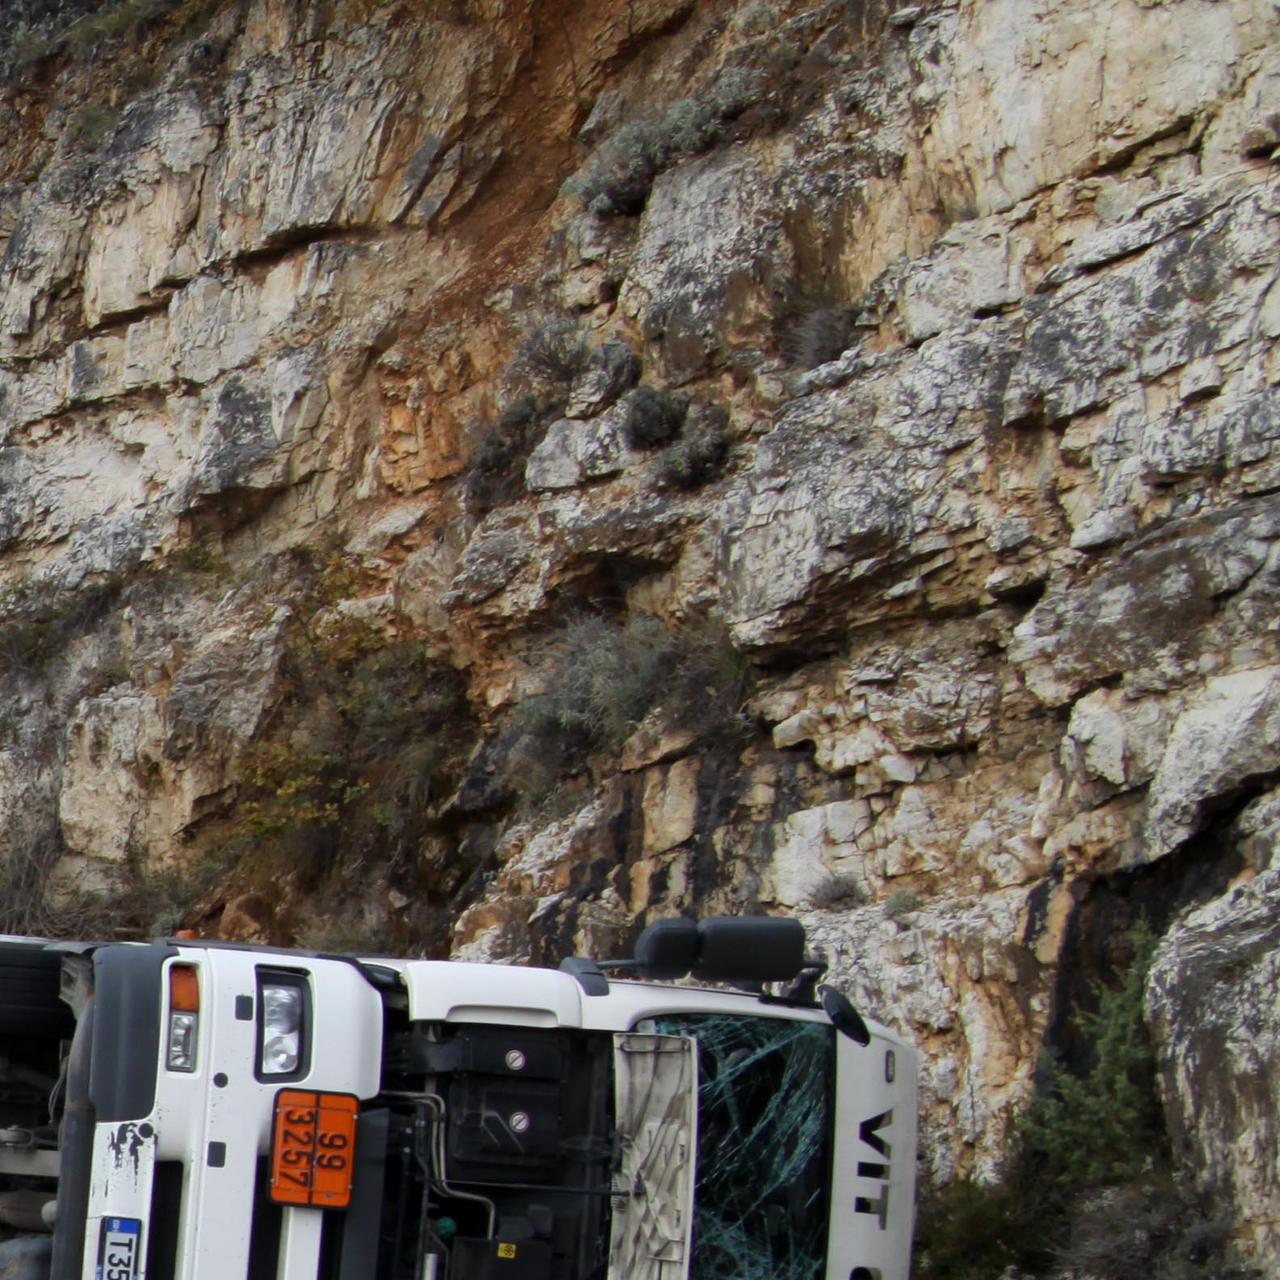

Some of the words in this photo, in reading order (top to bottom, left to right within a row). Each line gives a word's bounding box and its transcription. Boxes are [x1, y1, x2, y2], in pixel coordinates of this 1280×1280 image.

[280, 1110, 315, 1187] 3257
[317, 1133, 348, 1170] 99
[854, 1108, 893, 1230] VIT
